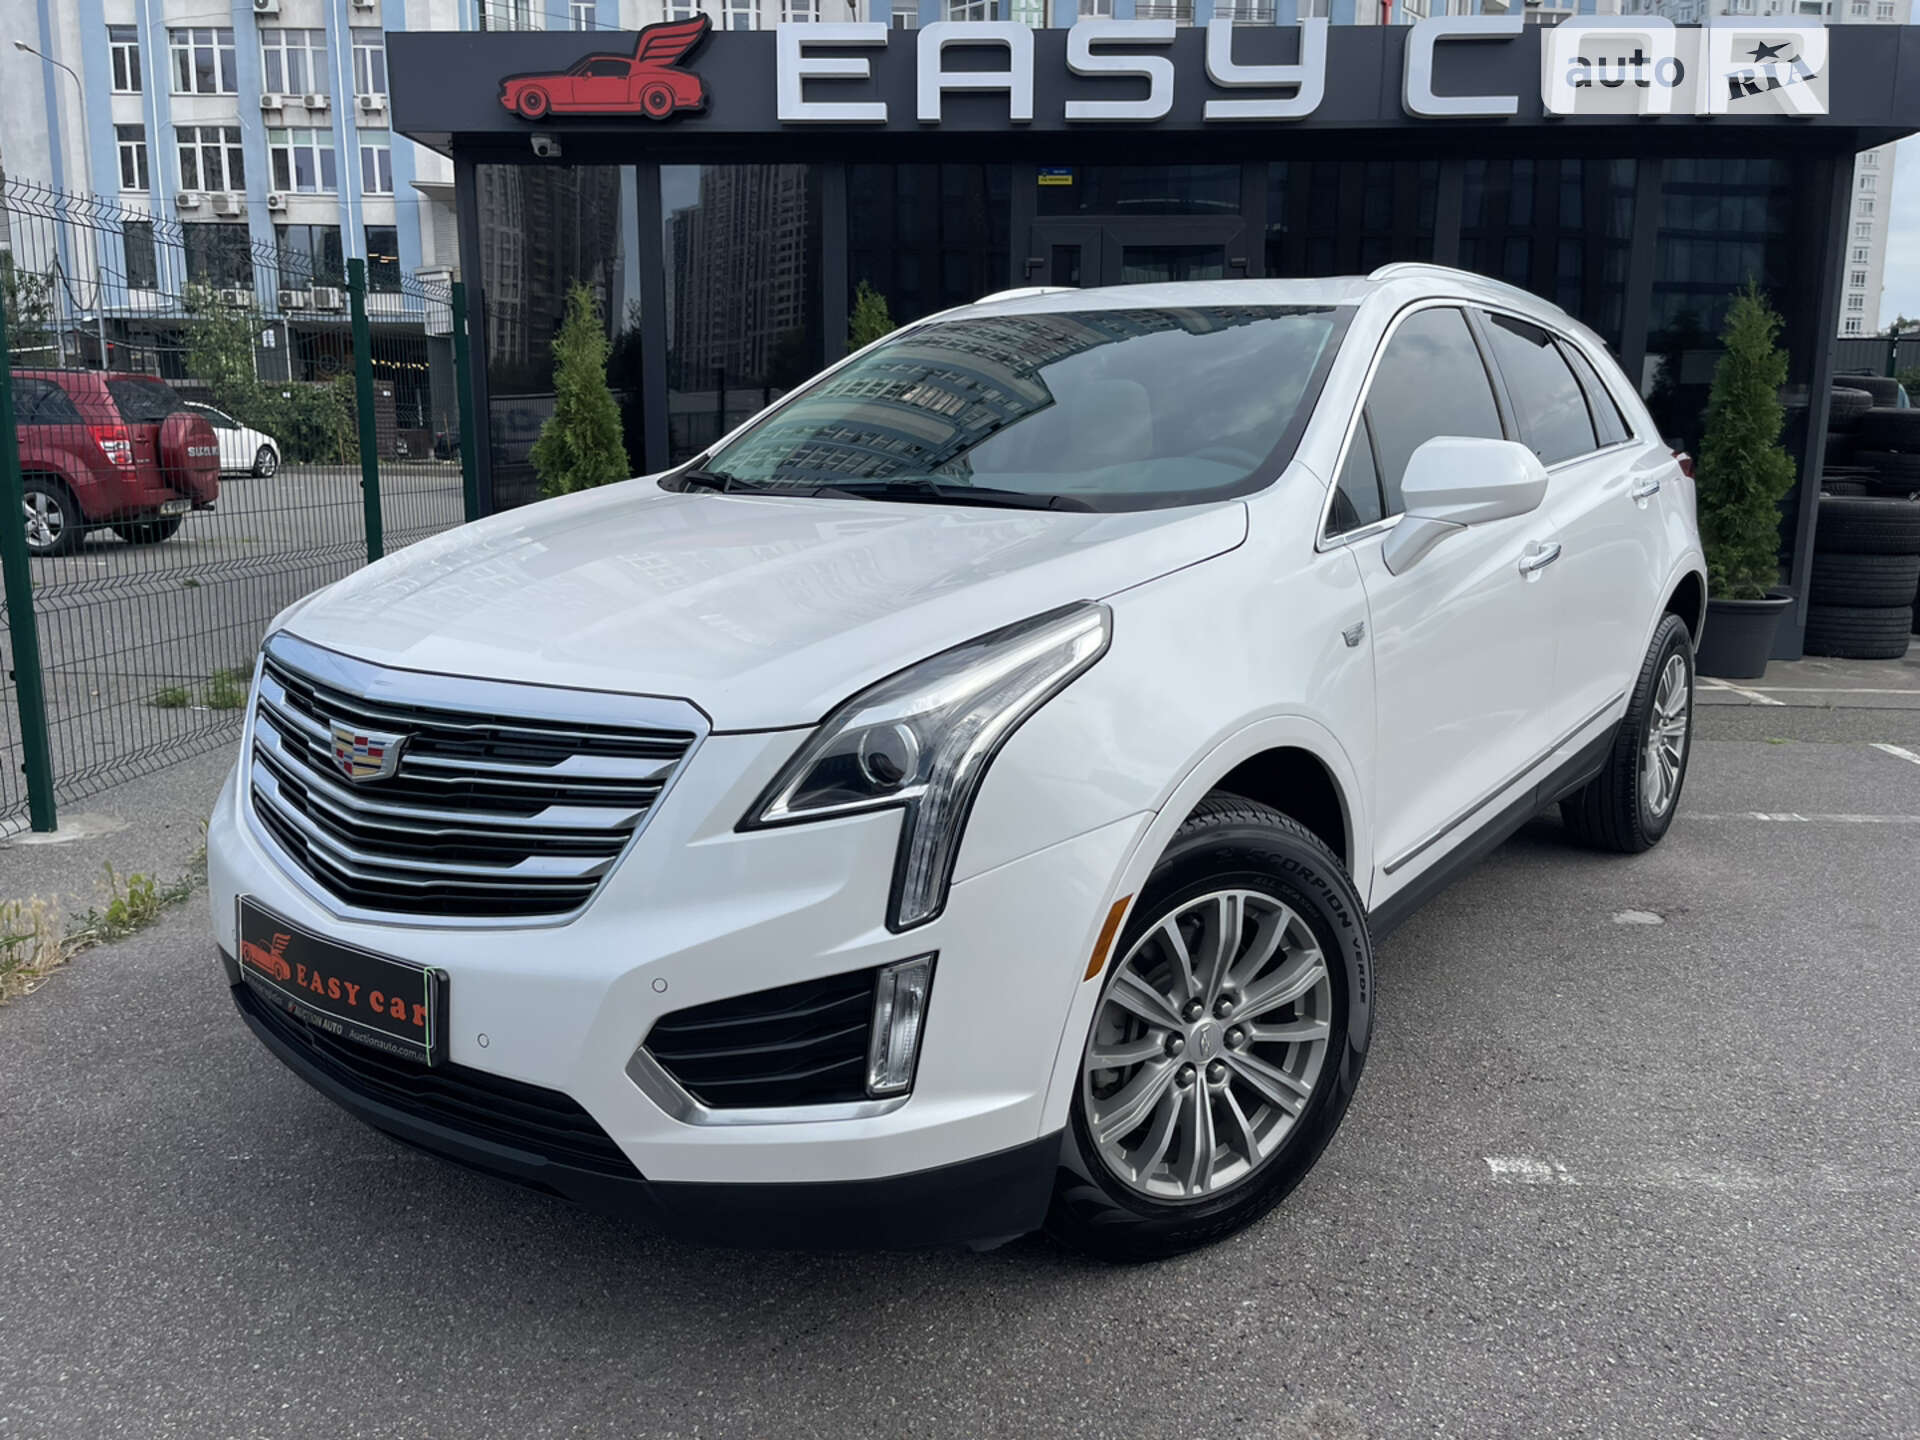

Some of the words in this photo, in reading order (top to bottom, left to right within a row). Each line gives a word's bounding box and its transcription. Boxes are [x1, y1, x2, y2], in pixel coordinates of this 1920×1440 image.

[777, 17, 1328, 122] EASY
[1401, 14, 1827, 119] CAR
[1248, 850, 1353, 929] SCORPION
[1352, 937, 1367, 1004] VERDE
[295, 963, 361, 1006] EASY
[322, 1018, 343, 1035] AUTO
[349, 1029, 429, 1061] Auctionauto.com.u
